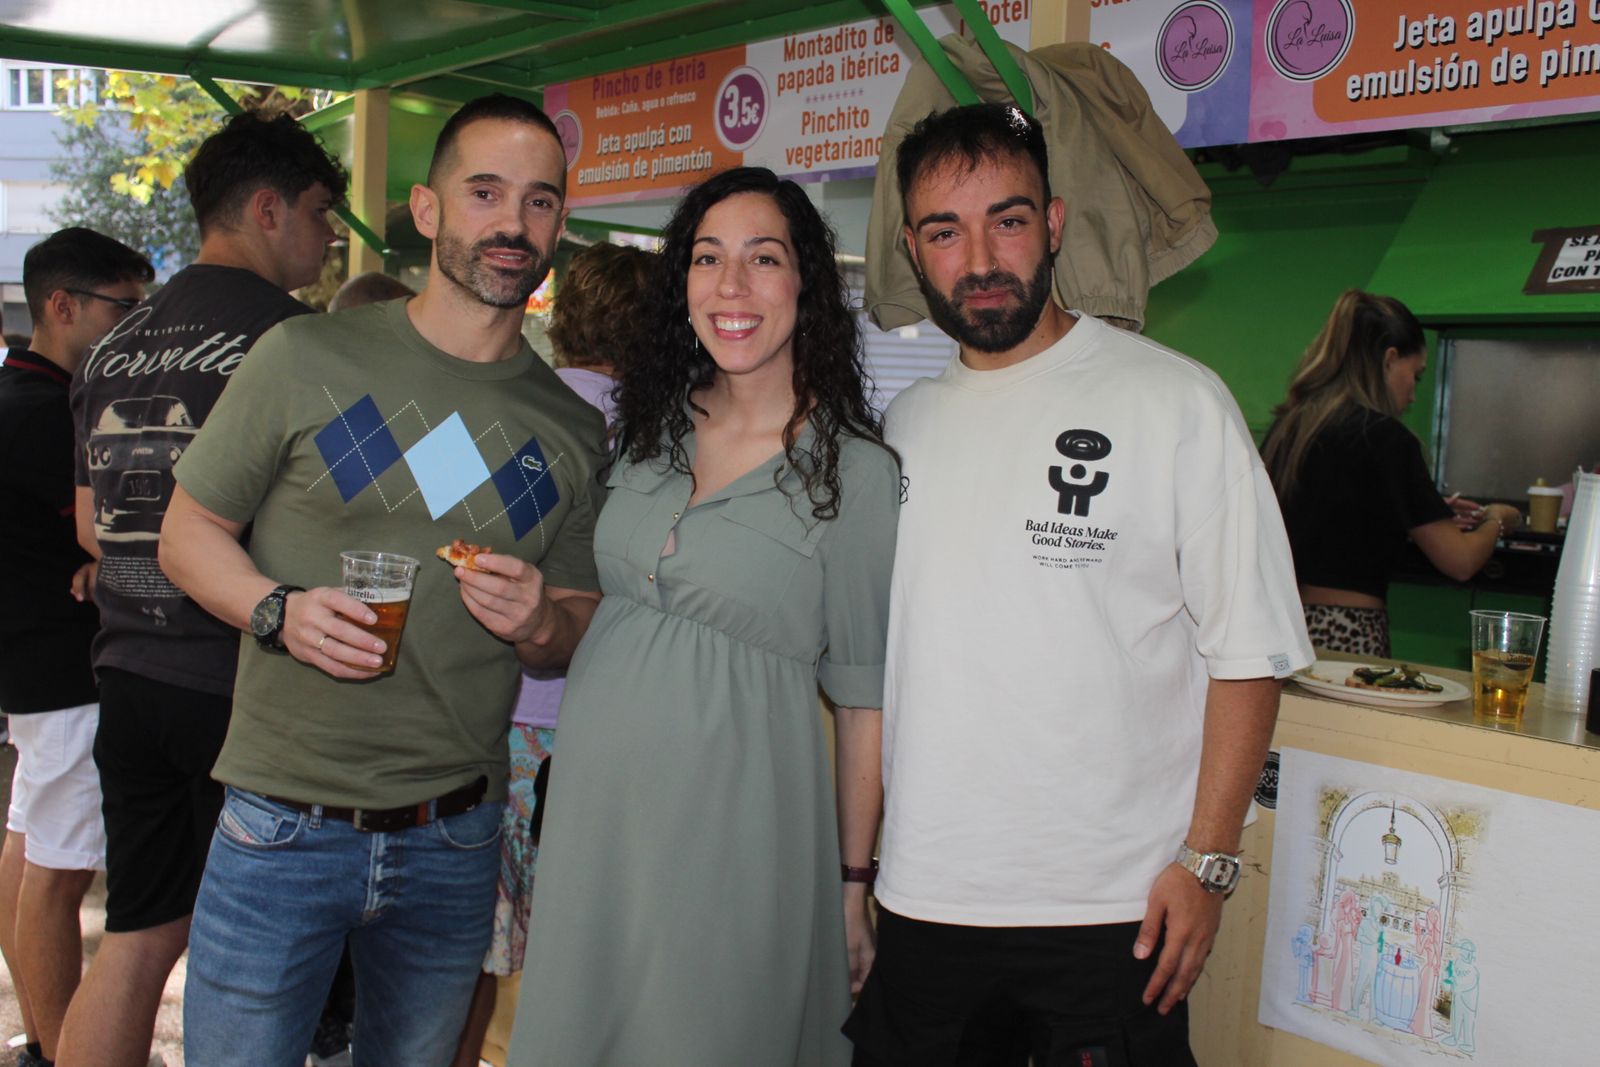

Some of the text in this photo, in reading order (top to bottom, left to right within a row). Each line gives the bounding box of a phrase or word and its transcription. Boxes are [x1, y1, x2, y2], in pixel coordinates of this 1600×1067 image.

[783, 17, 895, 63] Montadito de
[1284, 24, 1343, 50] La Luisa
[1393, 13, 1456, 51] Jeta
[1171, 38, 1223, 62] La Luisa
[592, 57, 706, 101] Pincho de feria
[777, 51, 900, 96] papada ibérica
[1346, 52, 1480, 101] emulsión
[1490, 47, 1528, 86] de
[642, 98, 659, 112] agua
[660, 97, 666, 107] o
[666, 91, 697, 106] refresco
[724, 84, 760, 129] 3.5€
[801, 105, 870, 136] Pinchito
[596, 134, 621, 155] Jeta
[669, 124, 692, 145] con
[578, 146, 713, 185] emulsión de pimentón
[1551, 265, 1589, 280] CON
[84, 306, 247, 383] Corvette
[1025, 519, 1118, 541] Bad Ideas Make
[1032, 534, 1106, 551] Good Stories.
